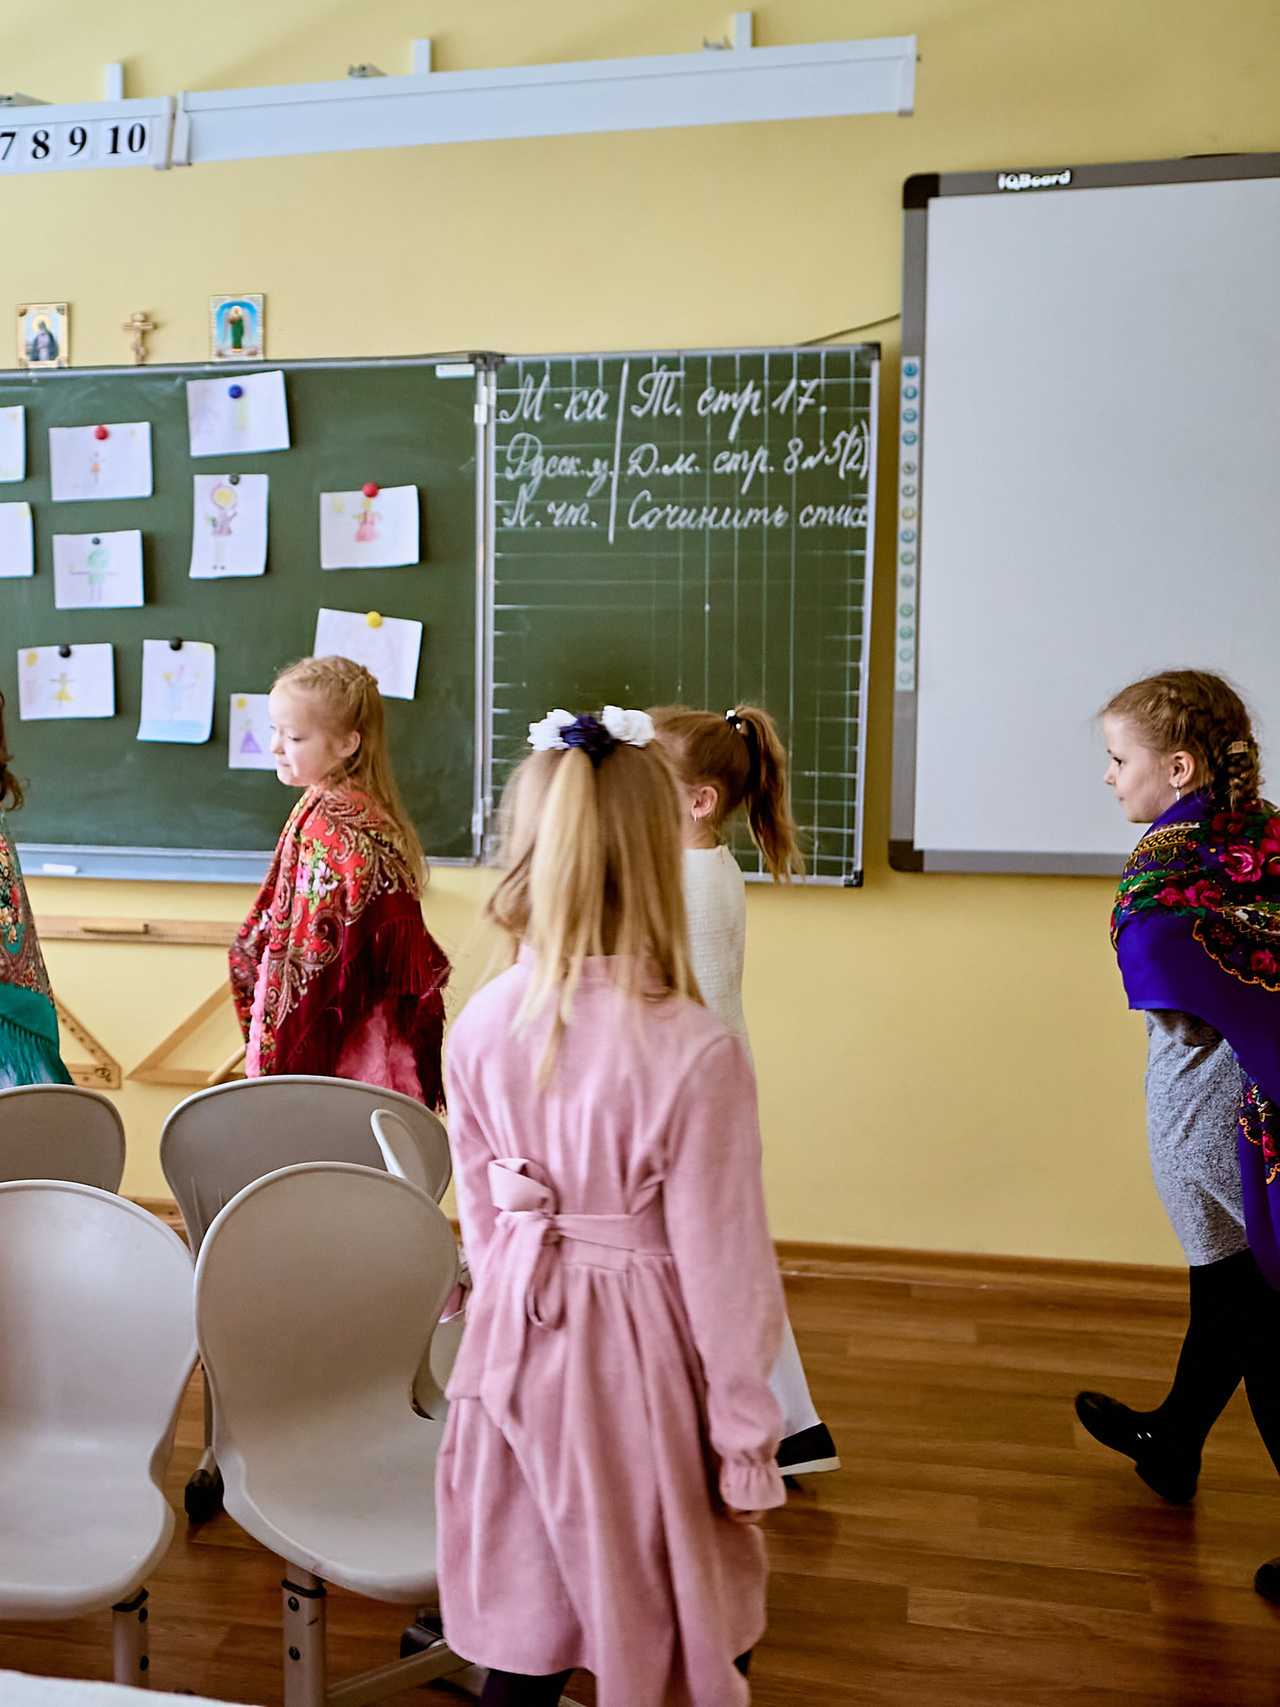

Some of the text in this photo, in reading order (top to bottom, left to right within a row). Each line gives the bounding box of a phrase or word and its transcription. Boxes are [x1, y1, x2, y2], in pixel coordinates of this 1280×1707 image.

[32, 130, 51, 159] 8
[69, 127, 87, 156] 9
[108, 122, 146, 155] 10
[998, 169, 1071, 191] IQBoard
[628, 489, 790, 530] Сочинить
